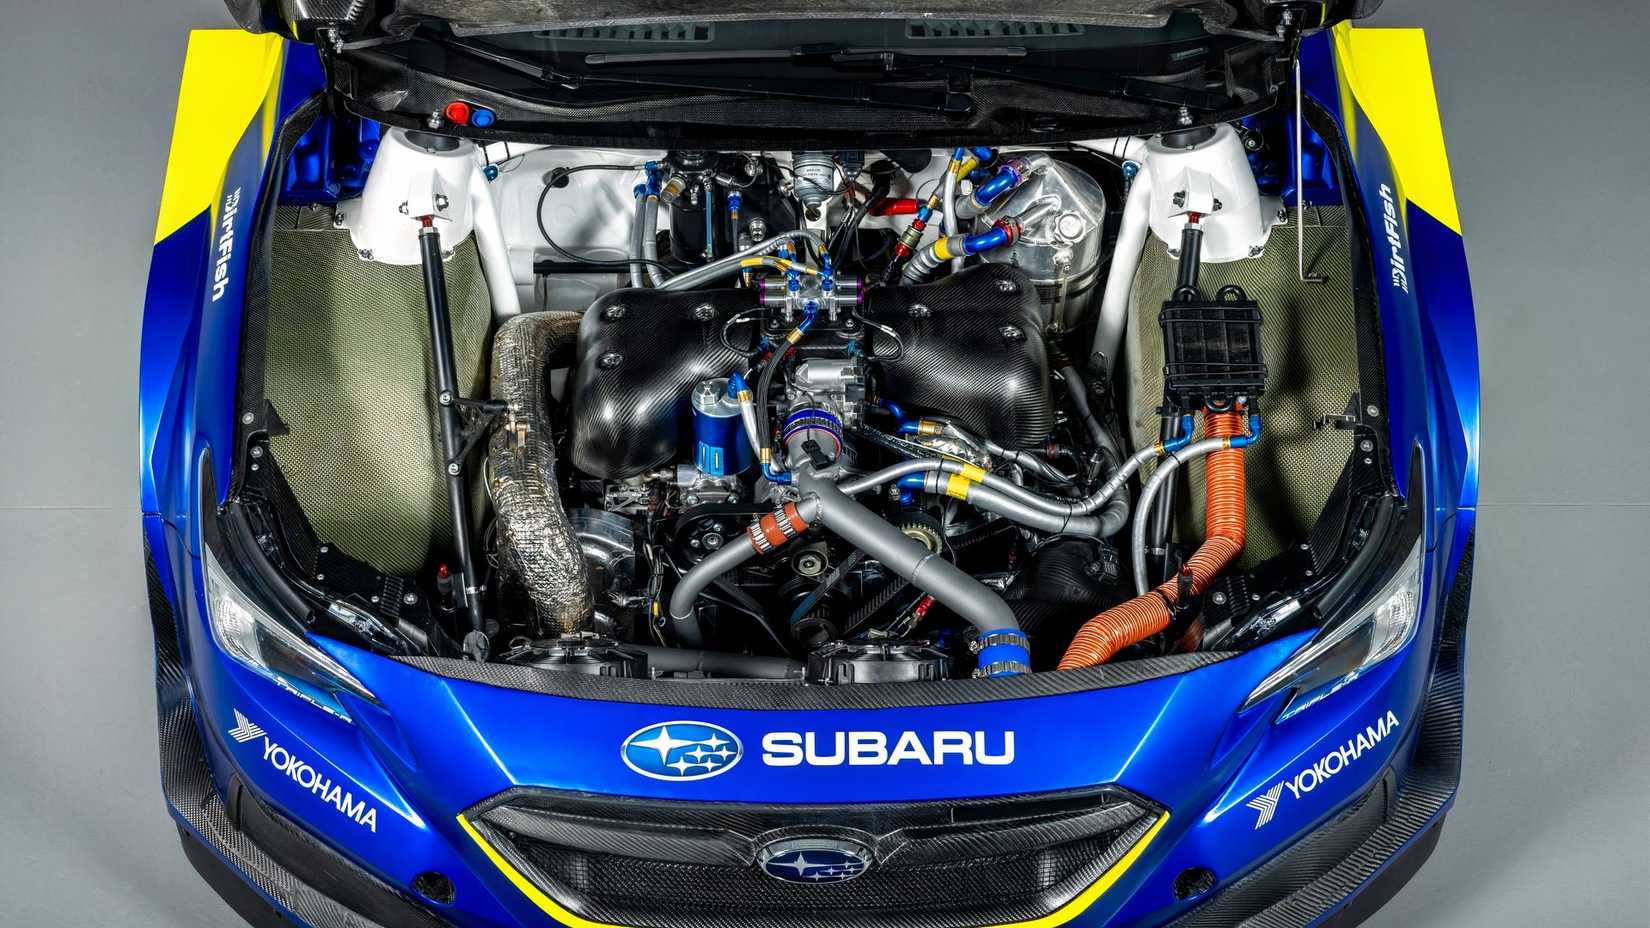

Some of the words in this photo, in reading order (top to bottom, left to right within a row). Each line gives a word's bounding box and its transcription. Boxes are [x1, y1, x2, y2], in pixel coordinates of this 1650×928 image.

[1379, 183, 1409, 294] DirtFish
[263, 736, 377, 833] YOKOHAMA
[762, 730, 1015, 767] SUBARU
[1285, 710, 1400, 800] YOKOHAMA
